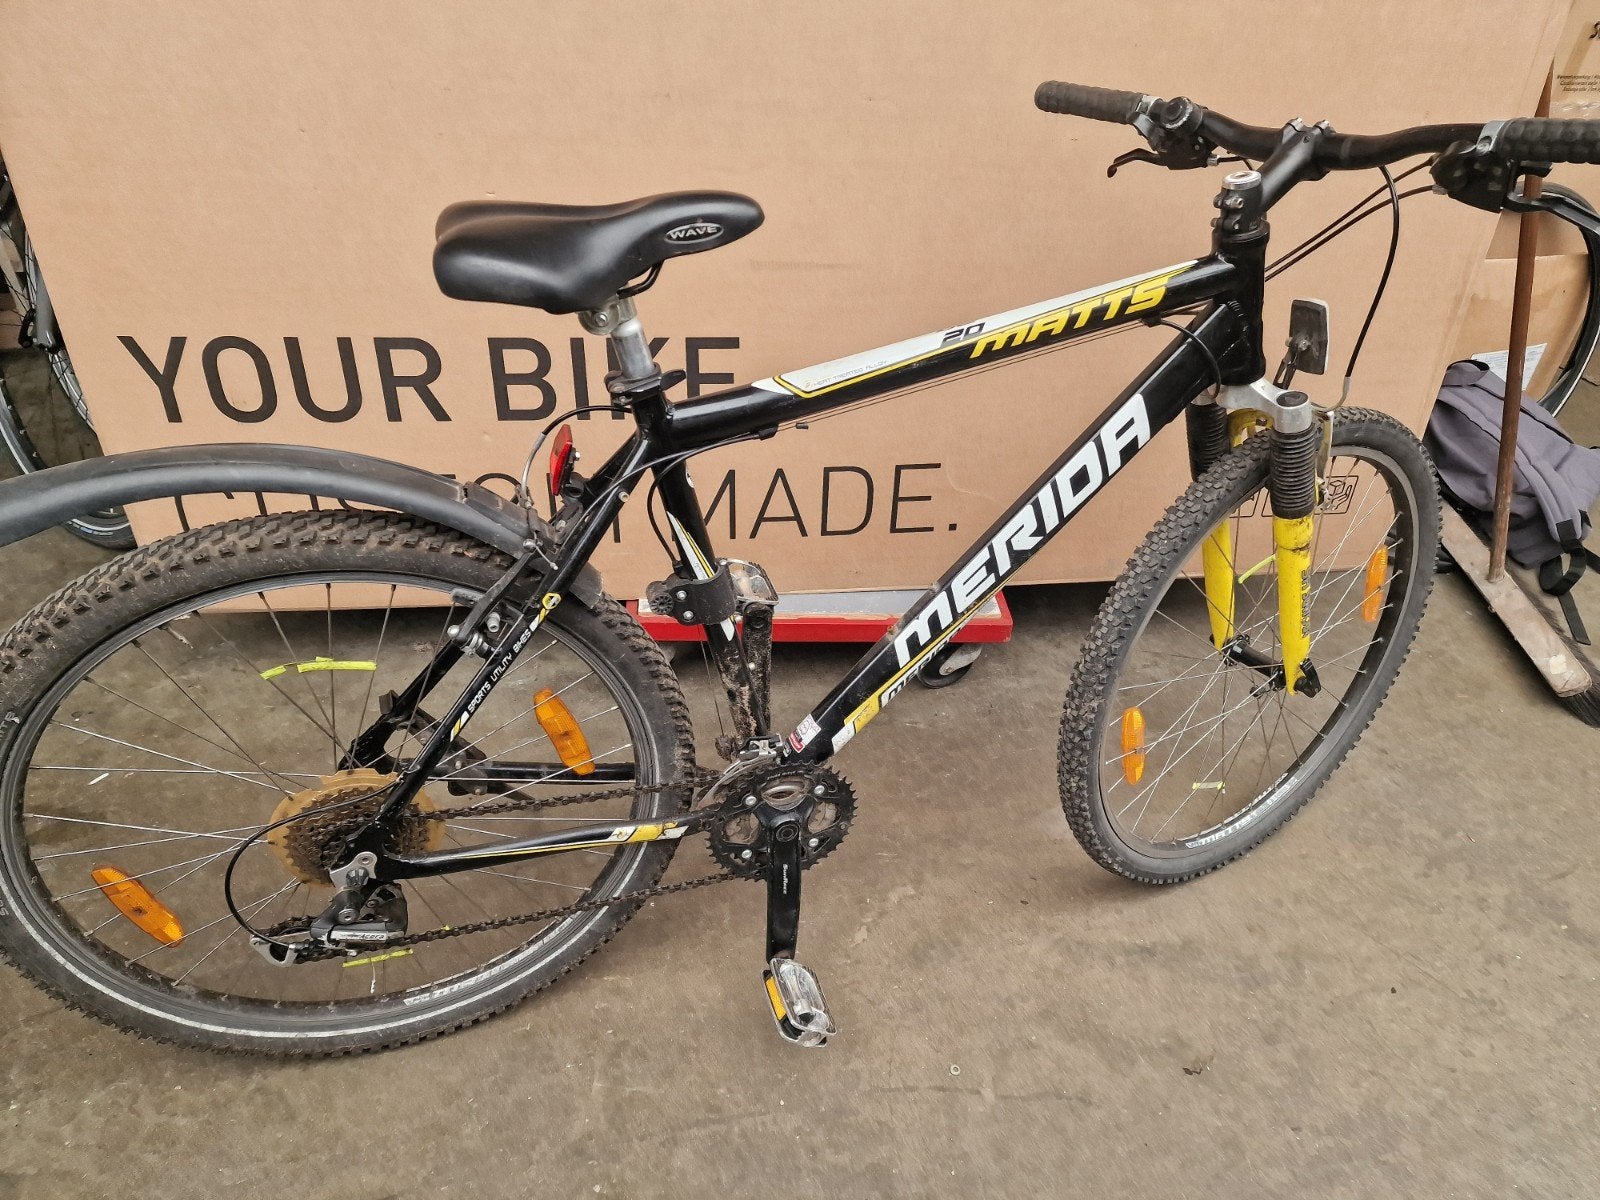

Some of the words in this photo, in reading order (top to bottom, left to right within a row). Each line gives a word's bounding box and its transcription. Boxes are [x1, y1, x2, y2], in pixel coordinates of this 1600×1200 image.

[670, 226, 717, 239] WAVE
[940, 322, 985, 346] 20
[970, 277, 1170, 358] MATTS
[117, 336, 452, 423] YOUR
[894, 393, 1151, 669] MERIDA
[467, 681, 492, 713] SPORTS
[490, 652, 513, 682] UTILITY
[512, 628, 532, 654] BIKES
